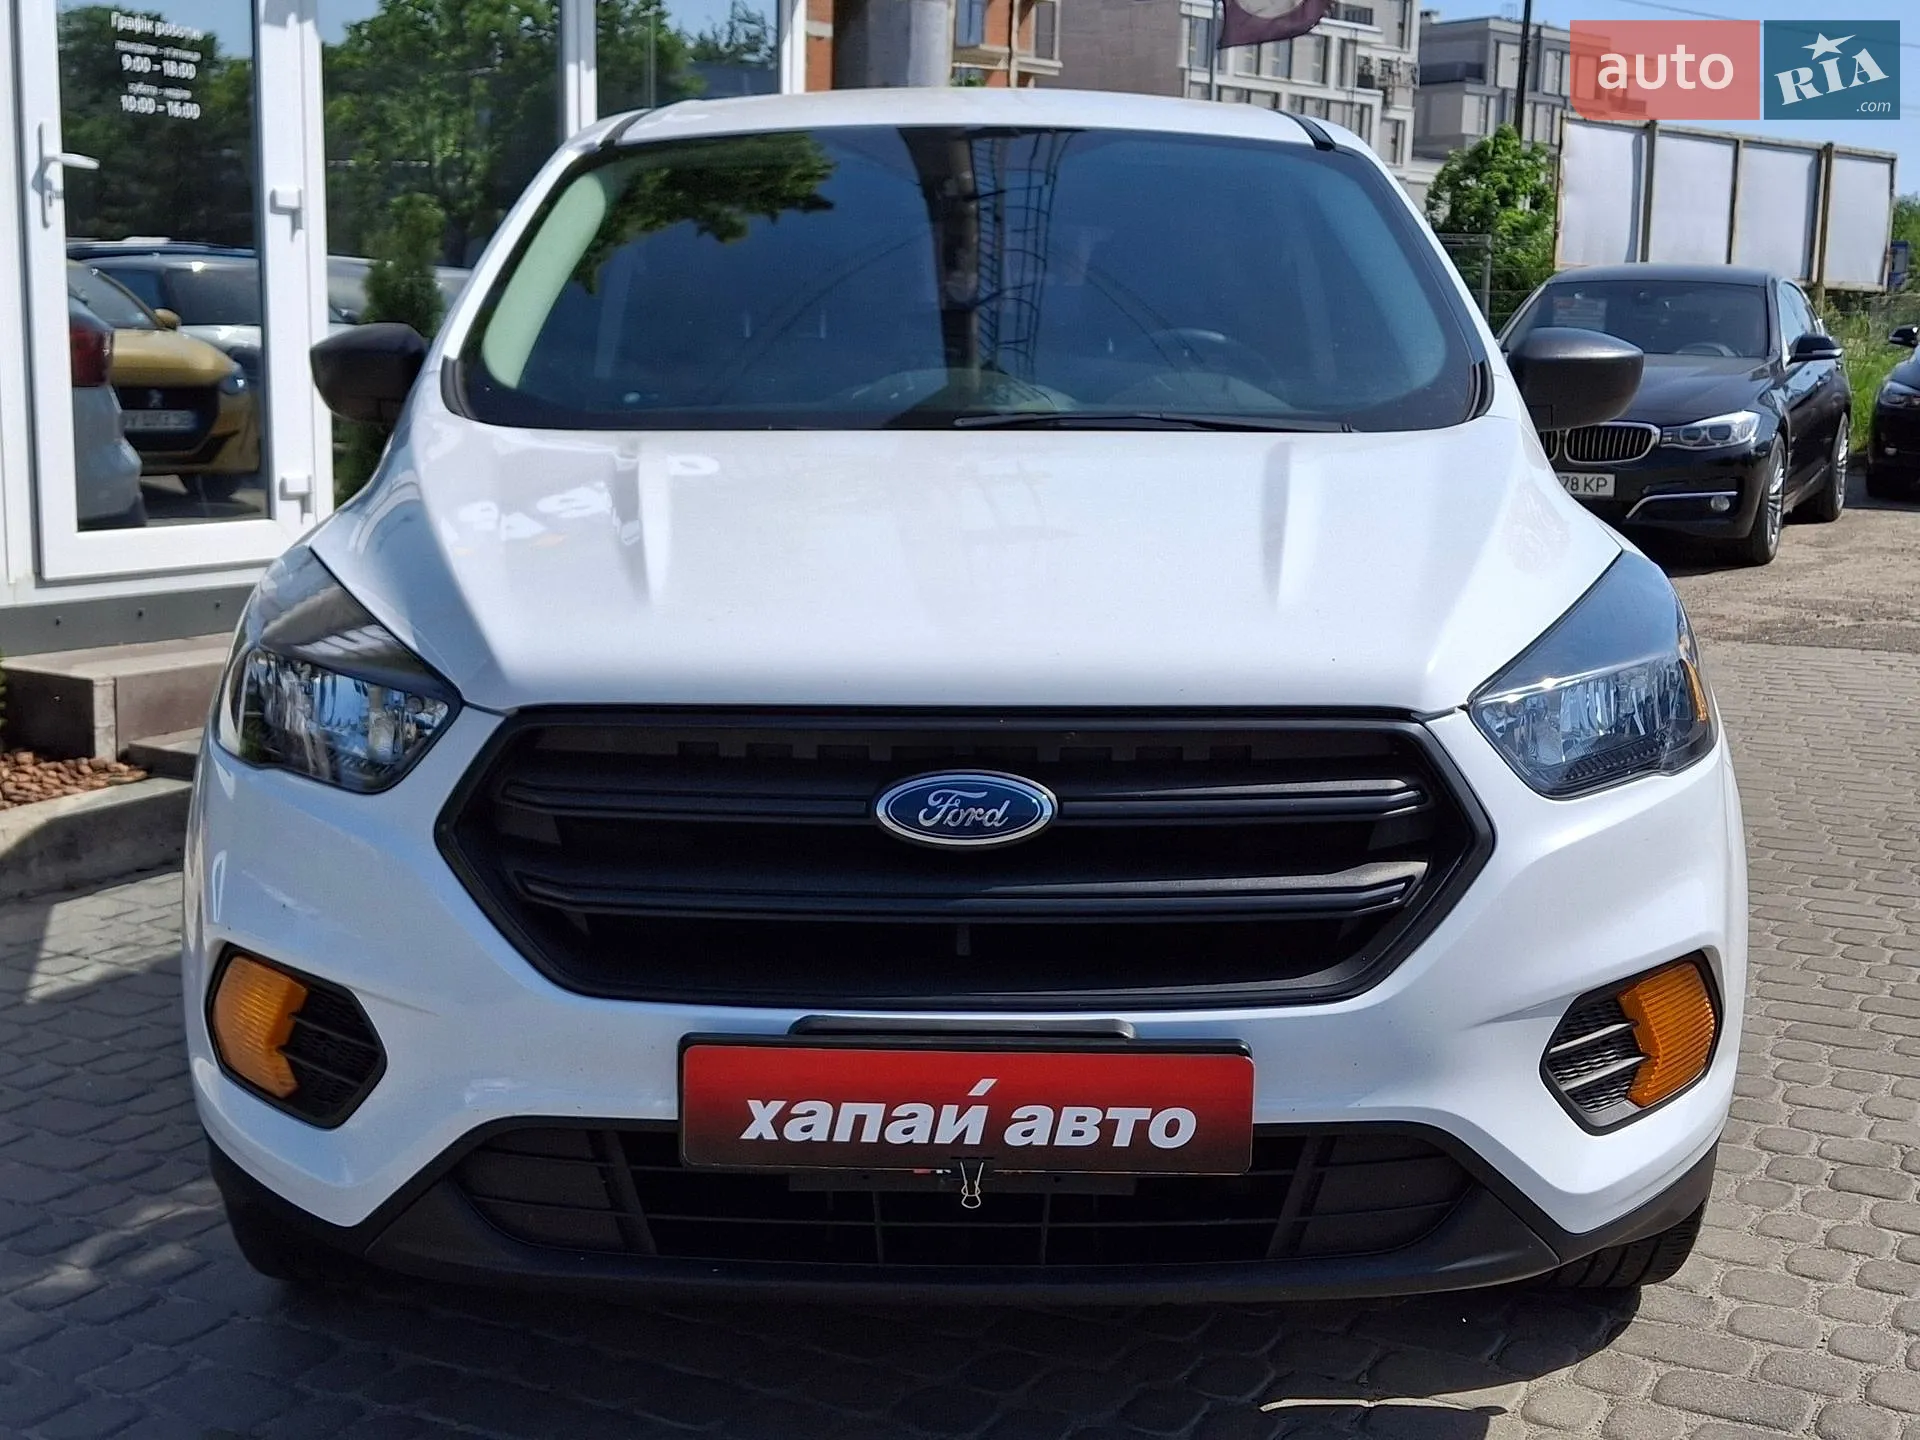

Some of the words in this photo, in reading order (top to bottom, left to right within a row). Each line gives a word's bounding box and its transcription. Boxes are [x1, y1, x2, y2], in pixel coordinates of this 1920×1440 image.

[1583, 476, 1608, 492] KP
[918, 789, 1011, 827] Ford
[1004, 1104, 1197, 1150] авто
